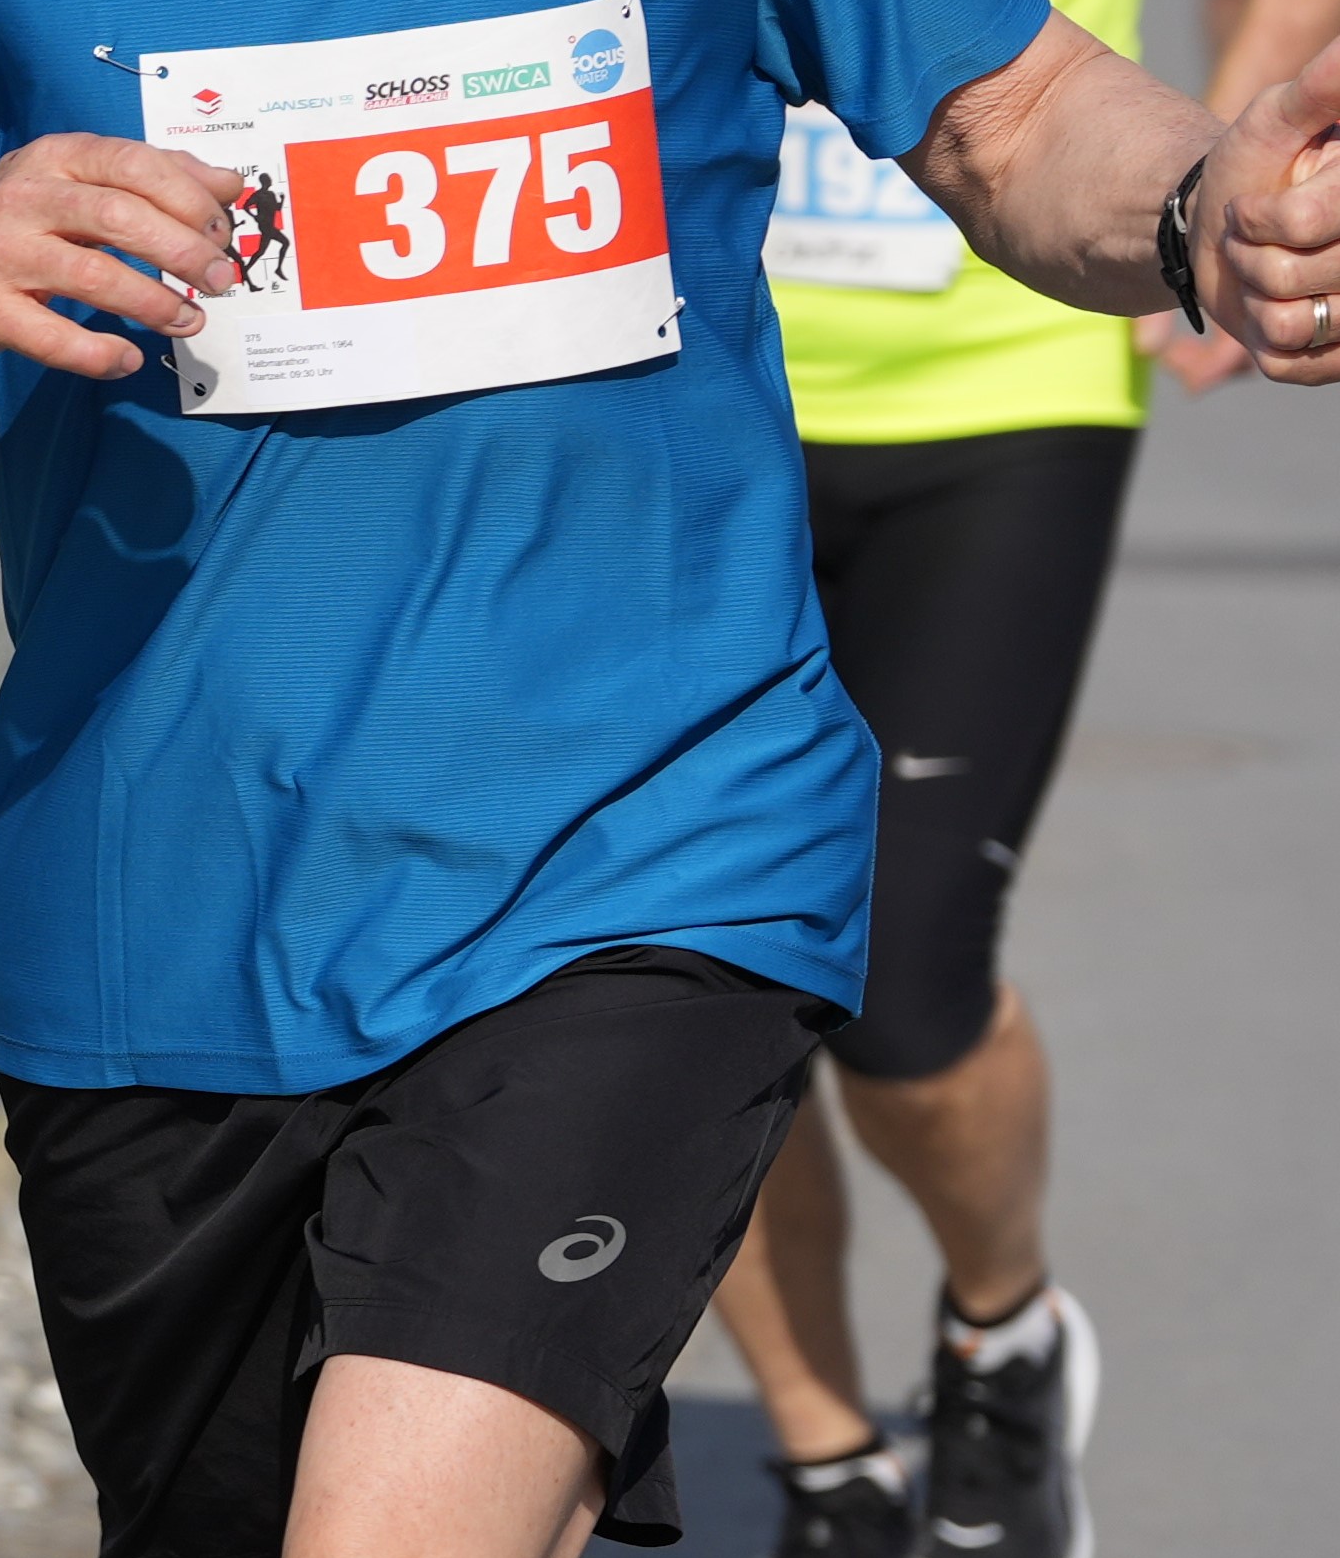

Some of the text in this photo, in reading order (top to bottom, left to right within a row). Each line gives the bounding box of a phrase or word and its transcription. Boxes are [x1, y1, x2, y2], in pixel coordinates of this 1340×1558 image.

[365, 74, 450, 100] SCHLOSS
[466, 64, 549, 97] SWICA
[260, 97, 333, 113] JANSEN
[354, 120, 623, 281] 375
[244, 333, 262, 343] 375
